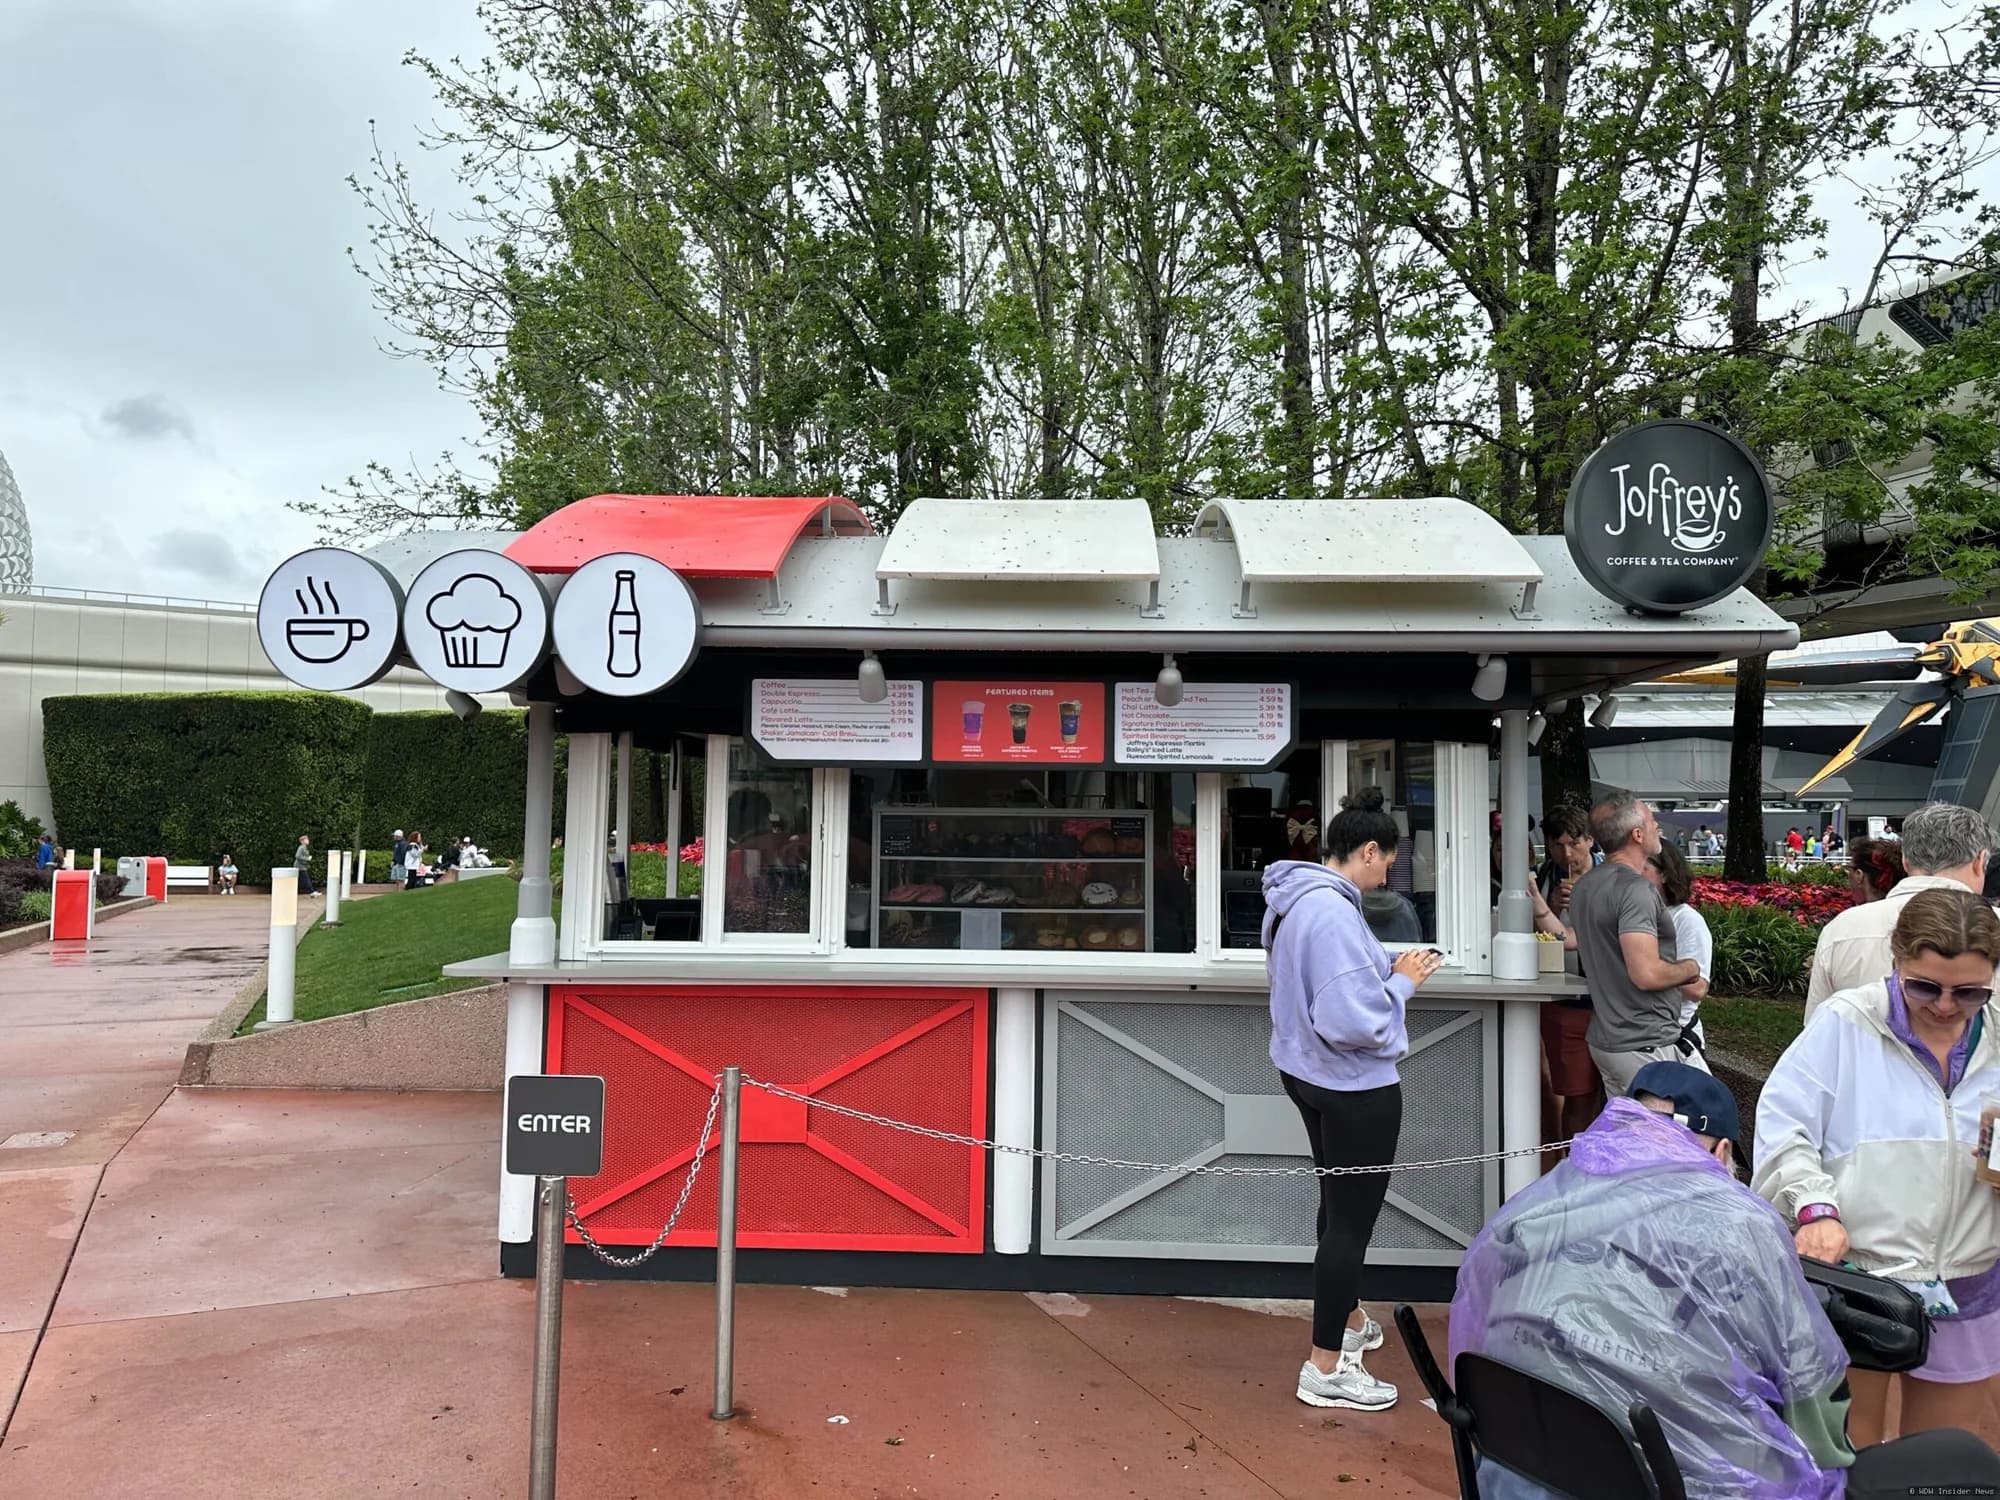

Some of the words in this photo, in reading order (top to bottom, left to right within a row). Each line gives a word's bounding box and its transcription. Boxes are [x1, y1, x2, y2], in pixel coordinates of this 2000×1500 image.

[1605, 463, 1742, 537] Joffrey's
[1606, 557, 1647, 566] COFFEE
[1649, 557, 1657, 566] &
[1661, 557, 1680, 566] TEA
[761, 681, 786, 689] Coffee
[788, 690, 820, 698] Espresso
[985, 688, 1028, 696] FEATURED
[1029, 688, 1054, 696] ITEMS
[761, 698, 802, 706] Cappuccino
[794, 716, 814, 724] Latte
[1121, 721, 1154, 729] Signature
[1122, 732, 1149, 740] Spirited
[517, 1113, 592, 1134] ENTER
